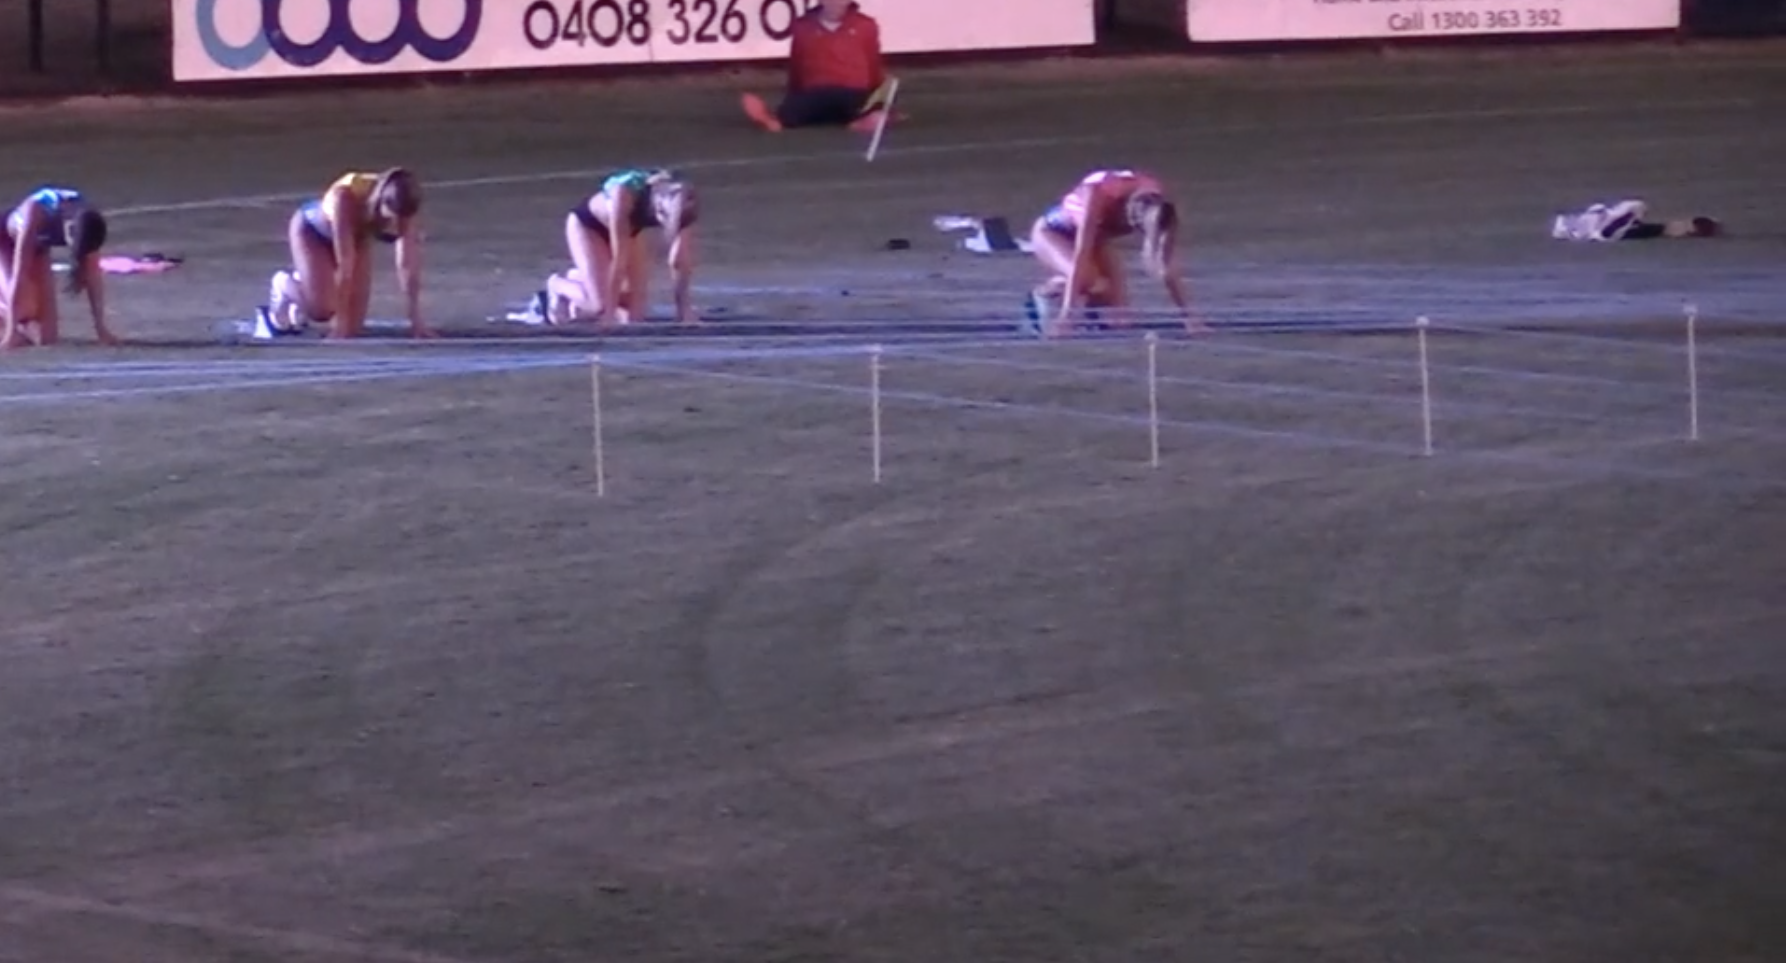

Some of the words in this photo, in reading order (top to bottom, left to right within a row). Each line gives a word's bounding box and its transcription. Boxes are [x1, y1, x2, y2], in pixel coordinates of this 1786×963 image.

[1388, 12, 1425, 31] Call
[1432, 10, 1480, 29] 1300
[1485, 8, 1522, 28] 363
[1527, 7, 1562, 27] 392
